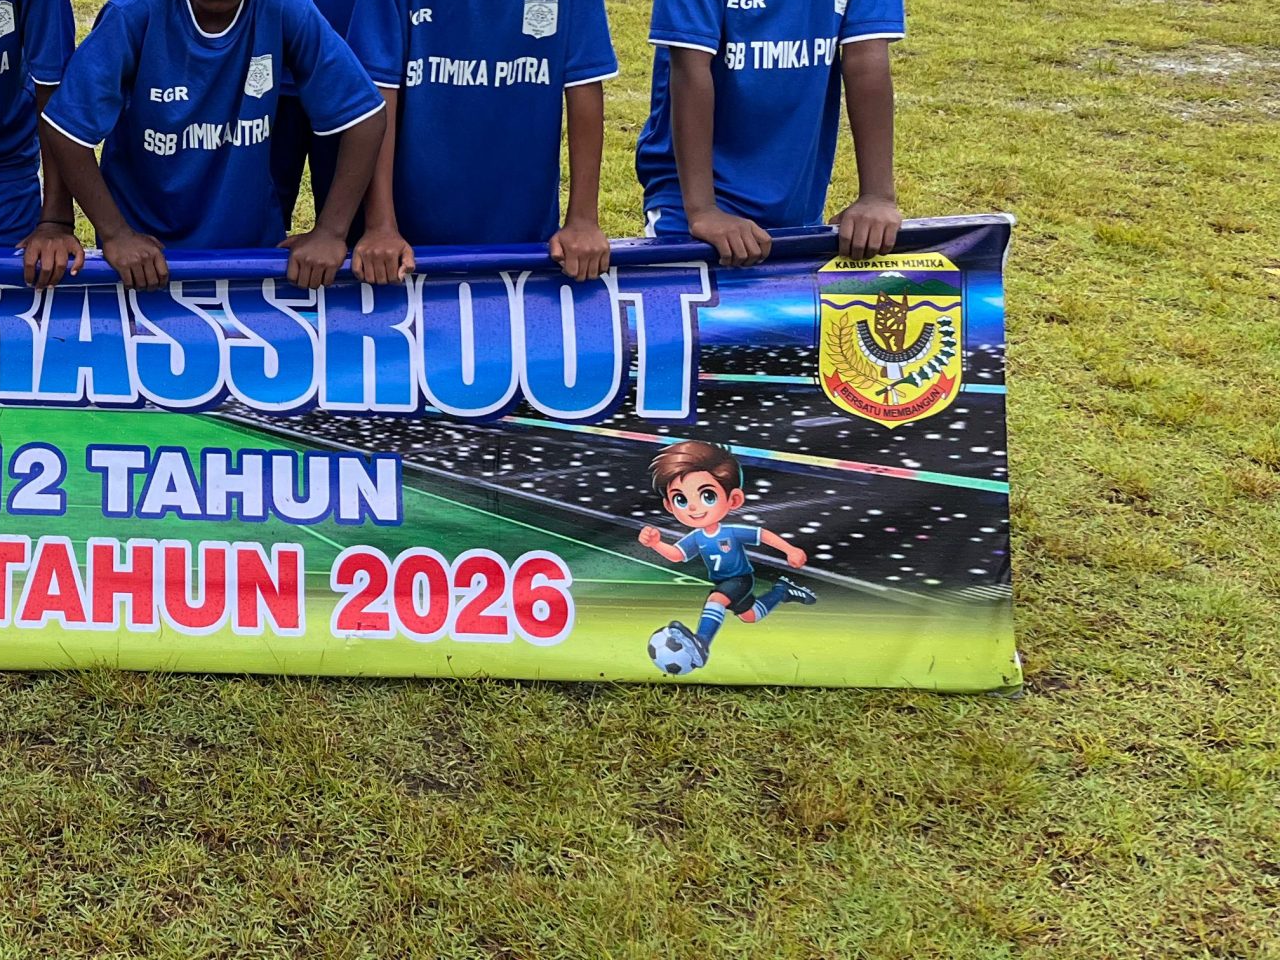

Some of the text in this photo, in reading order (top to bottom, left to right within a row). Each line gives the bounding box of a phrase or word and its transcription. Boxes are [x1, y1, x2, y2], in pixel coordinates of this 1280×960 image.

[750, 40, 809, 69] TIMIKA
[428, 56, 488, 86] TIMIKA
[495, 56, 550, 87] PUTRA
[150, 86, 189, 102] EGR
[144, 128, 177, 156] SSB
[835, 258, 945, 270] KABUPATEN MIMIKA
[840, 386, 940, 417] BERSATU MEMBANGUN
[88, 449, 403, 524] TAHUN
[708, 554, 722, 571] 7
[330, 544, 575, 647] 2026
